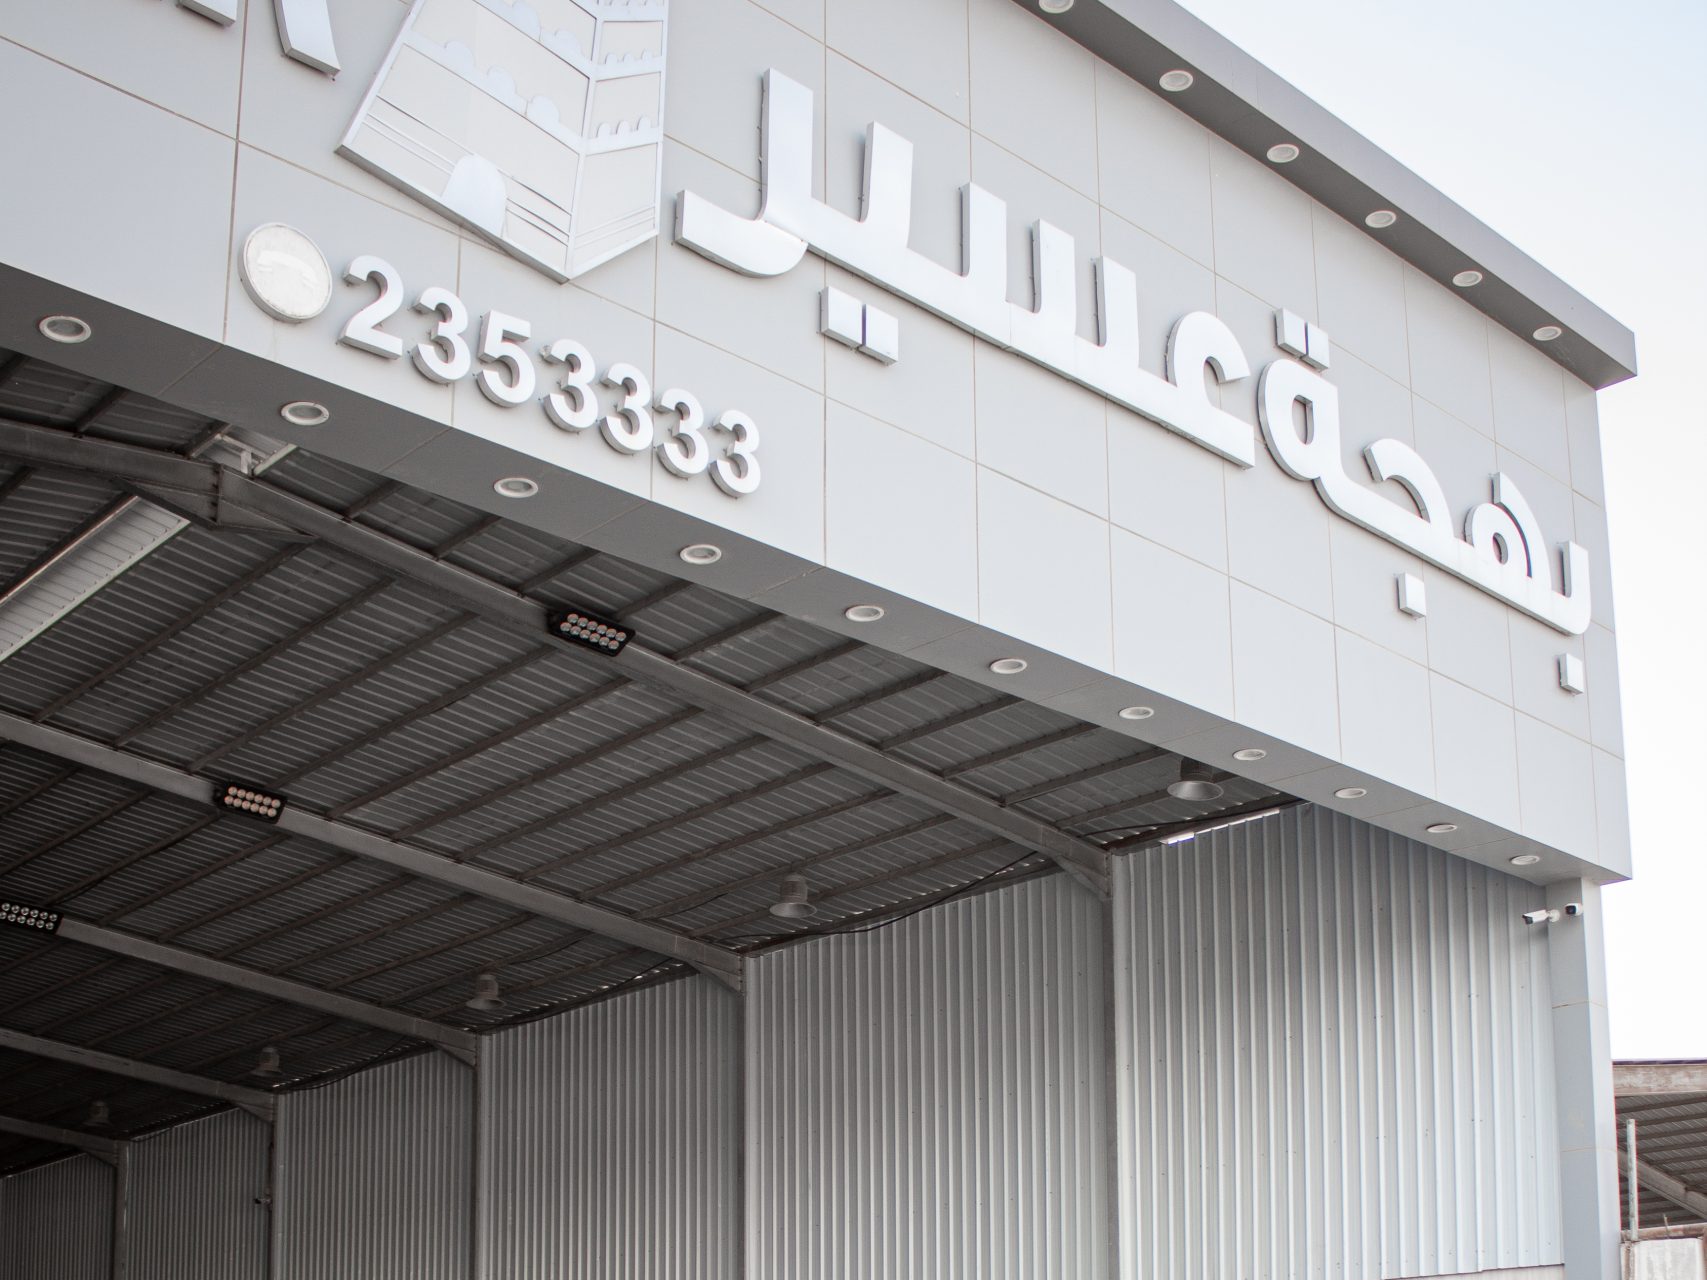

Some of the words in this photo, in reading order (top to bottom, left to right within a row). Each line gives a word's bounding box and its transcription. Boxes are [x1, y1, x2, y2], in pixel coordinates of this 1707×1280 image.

[336, 254, 762, 499] 2353333
[673, 68, 1255, 468] عسير
[1256, 308, 1590, 694] بهجة
